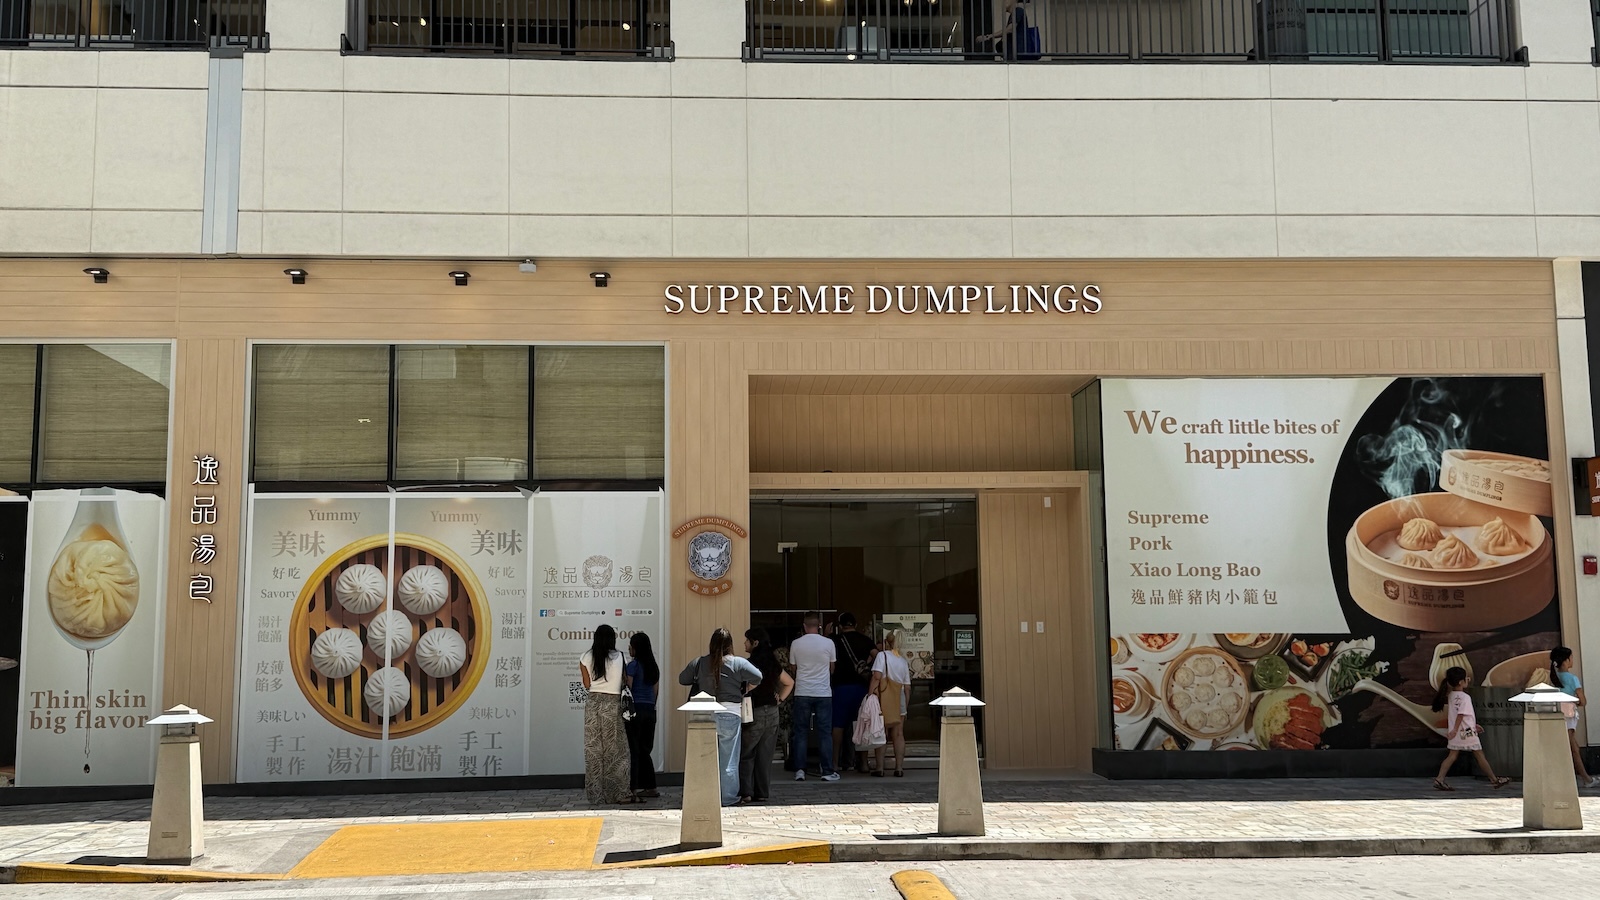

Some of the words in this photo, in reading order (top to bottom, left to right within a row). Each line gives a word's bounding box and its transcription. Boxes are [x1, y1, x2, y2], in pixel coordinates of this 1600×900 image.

[665, 285, 854, 312] SUPREME
[867, 285, 1101, 313] DUMPLINGS
[1124, 411, 1177, 434] We
[1182, 419, 1223, 434] craft
[1229, 420, 1269, 434] little
[1274, 419, 1316, 434] bites
[1321, 419, 1340, 434] of
[1184, 443, 1314, 469] happiness.
[309, 510, 360, 524] Yummy
[431, 511, 481, 525] Yummy
[1128, 511, 1208, 527] Supreme
[190, 455, 219, 604] 逸品湯包
[674, 518, 706, 537] SUPREME
[706, 518, 744, 536] DUMPLINGS
[272, 531, 325, 557] 美味
[471, 530, 522, 555] 美味
[1129, 536, 1172, 550] Pork
[273, 567, 300, 579] 好吃
[488, 566, 514, 578] 好吃
[1130, 562, 1171, 576] Xiao
[1177, 563, 1222, 580] Long
[1227, 563, 1260, 576] Bao
[261, 589, 298, 601] Savory
[496, 588, 525, 598] Savory
[543, 590, 589, 599] SUPREME
[593, 589, 651, 598] DUMPLINGS
[257, 615, 283, 629] 湯汁
[501, 612, 526, 626] 湯汁
[548, 627, 596, 641] Comin
[256, 660, 284, 675] 皮薄
[495, 656, 523, 671] 皮薄
[30, 690, 87, 709] Thin
[96, 689, 146, 708] skin
[257, 710, 306, 723] 美味しい
[469, 706, 517, 720] 美味しい
[30, 711, 66, 734] big
[75, 710, 148, 729] flavor
[267, 735, 305, 753] 手工
[458, 731, 503, 752] 手工
[267, 757, 305, 775] 製作
[328, 747, 379, 774] 湯汁
[391, 745, 442, 771] 飽滿
[460, 756, 503, 777] 製作
